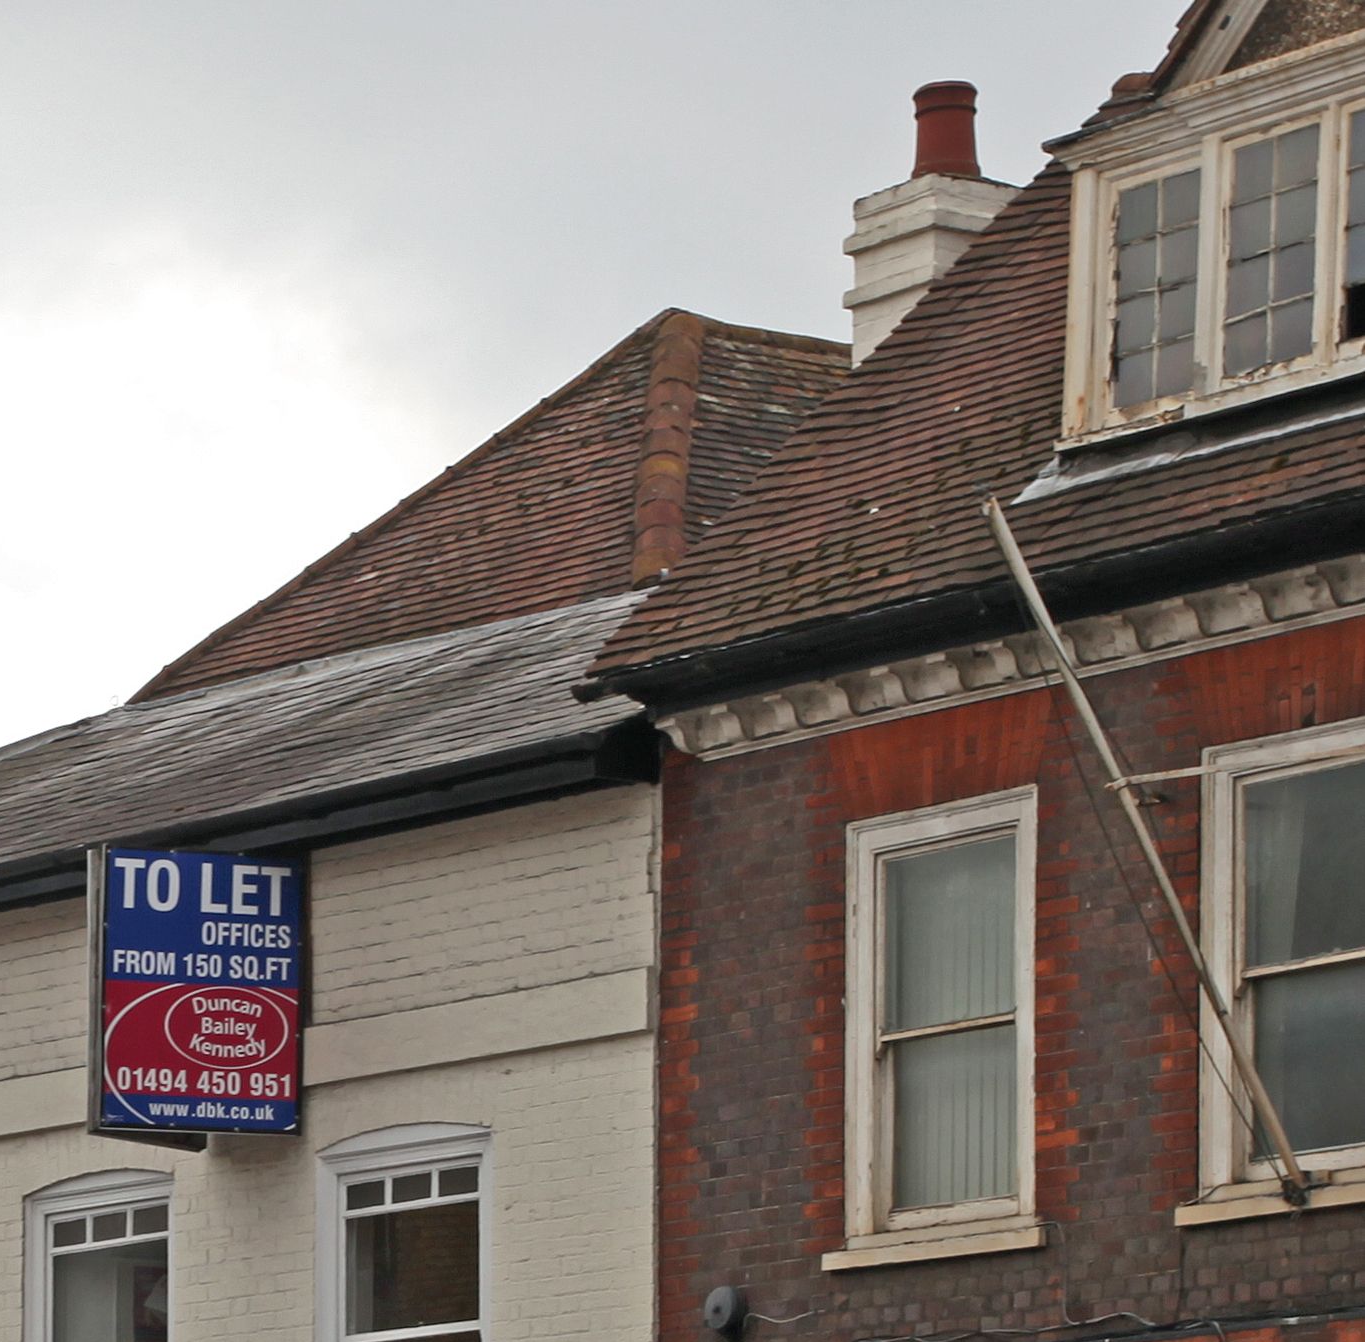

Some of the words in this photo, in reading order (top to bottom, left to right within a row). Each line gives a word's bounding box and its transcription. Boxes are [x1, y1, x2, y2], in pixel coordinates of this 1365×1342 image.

[114, 858, 181, 912] TO
[200, 862, 292, 917] LET
[201, 921, 291, 949] OFFICES
[112, 949, 175, 976] FROM
[183, 953, 222, 978] 150
[229, 955, 291, 981] SQ.FT
[192, 996, 263, 1018] Duncan
[201, 1017, 257, 1040] Bailey
[189, 1033, 266, 1058] Kennedy
[117, 1066, 188, 1092] 01494
[196, 1071, 241, 1096] 450
[249, 1073, 291, 1097] 951
[148, 1102, 274, 1121] www.dbk.co.uk
